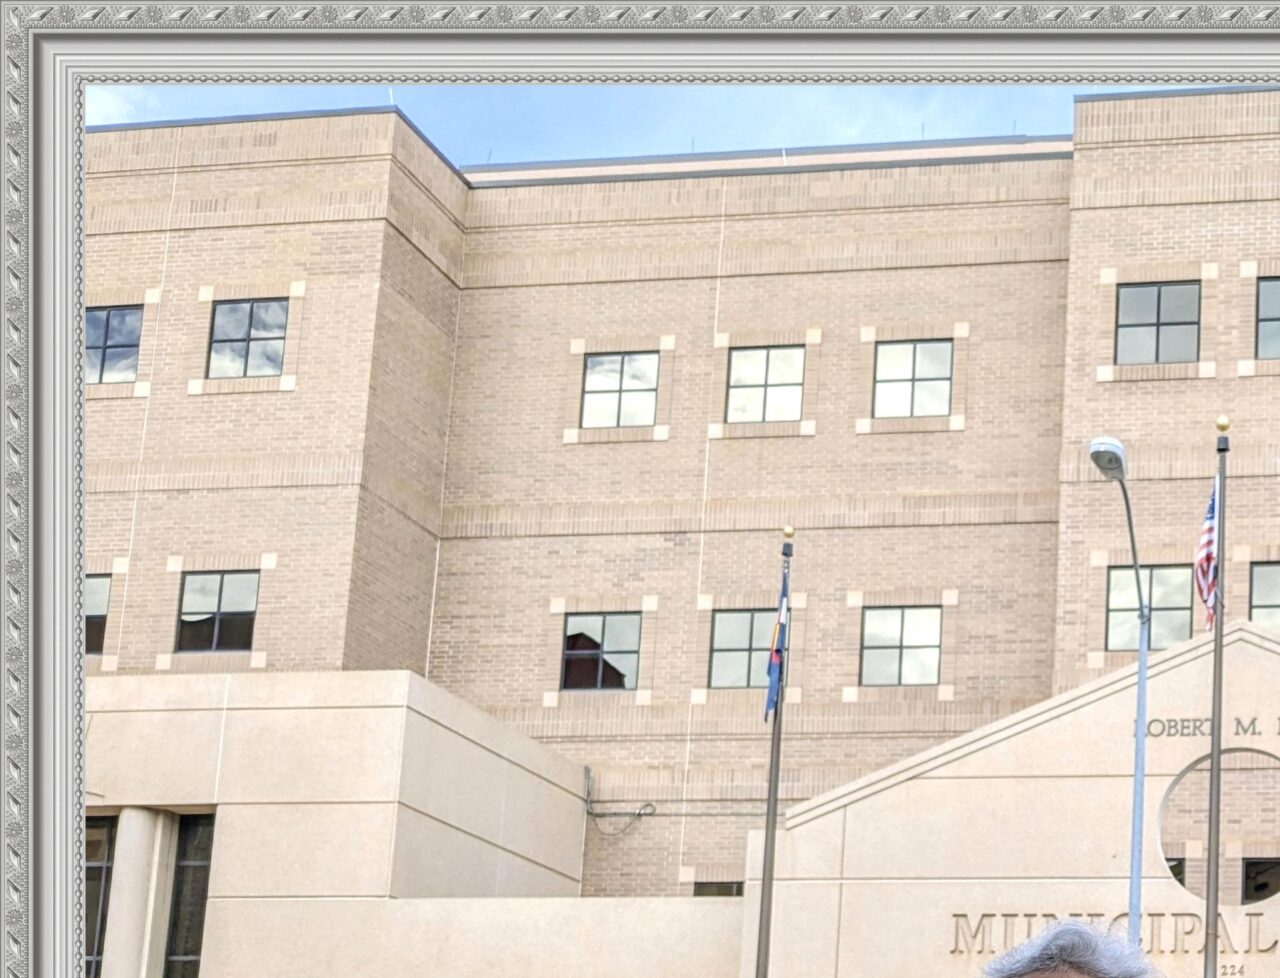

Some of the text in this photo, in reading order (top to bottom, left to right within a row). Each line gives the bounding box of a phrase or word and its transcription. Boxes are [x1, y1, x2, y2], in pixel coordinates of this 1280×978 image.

[1133, 718, 1214, 738] OBERT
[1234, 717, 1262, 736] M.
[949, 912, 1280, 955] MUIPAL
[1220, 964, 1245, 977] 224
